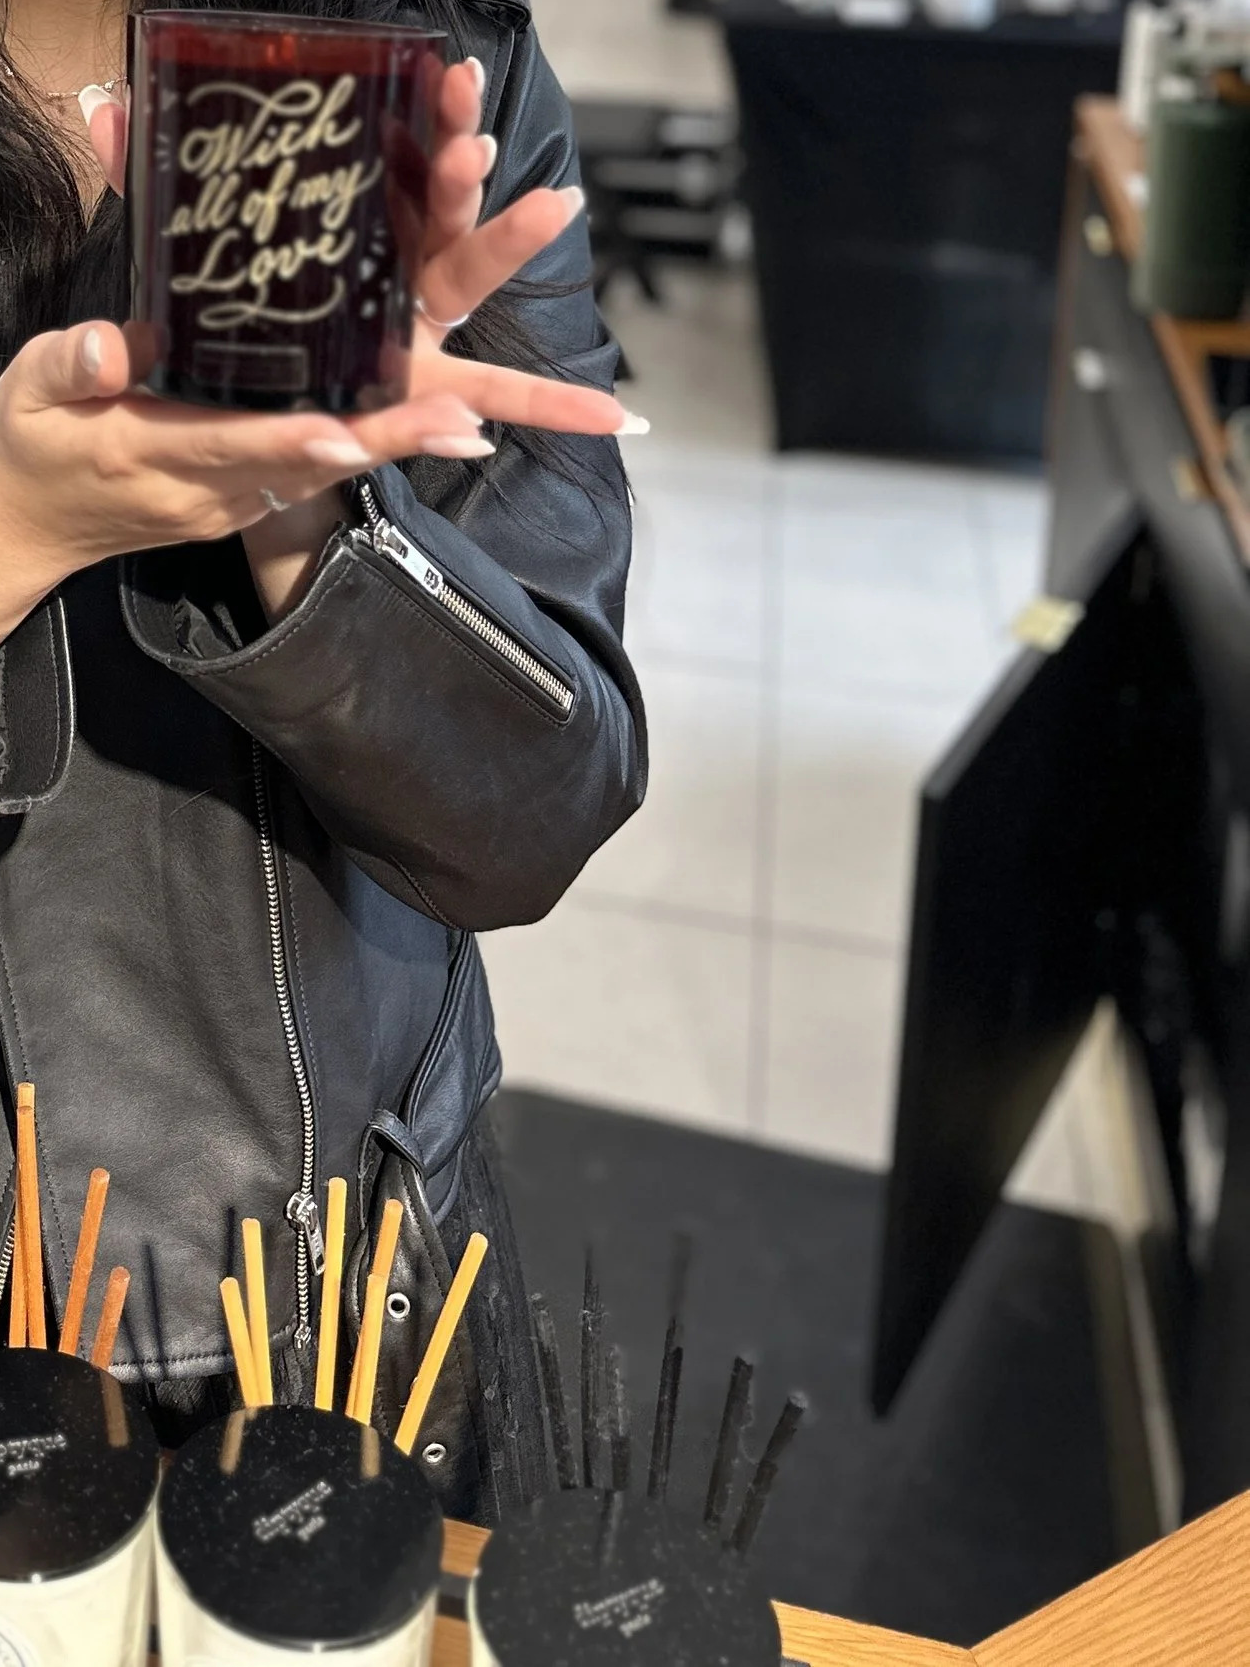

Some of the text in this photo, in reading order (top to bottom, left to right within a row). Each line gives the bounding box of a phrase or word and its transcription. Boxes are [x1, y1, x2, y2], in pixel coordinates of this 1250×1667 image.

[180, 75, 361, 179] With
[162, 156, 383, 242] all of my
[170, 228, 355, 304] Love
